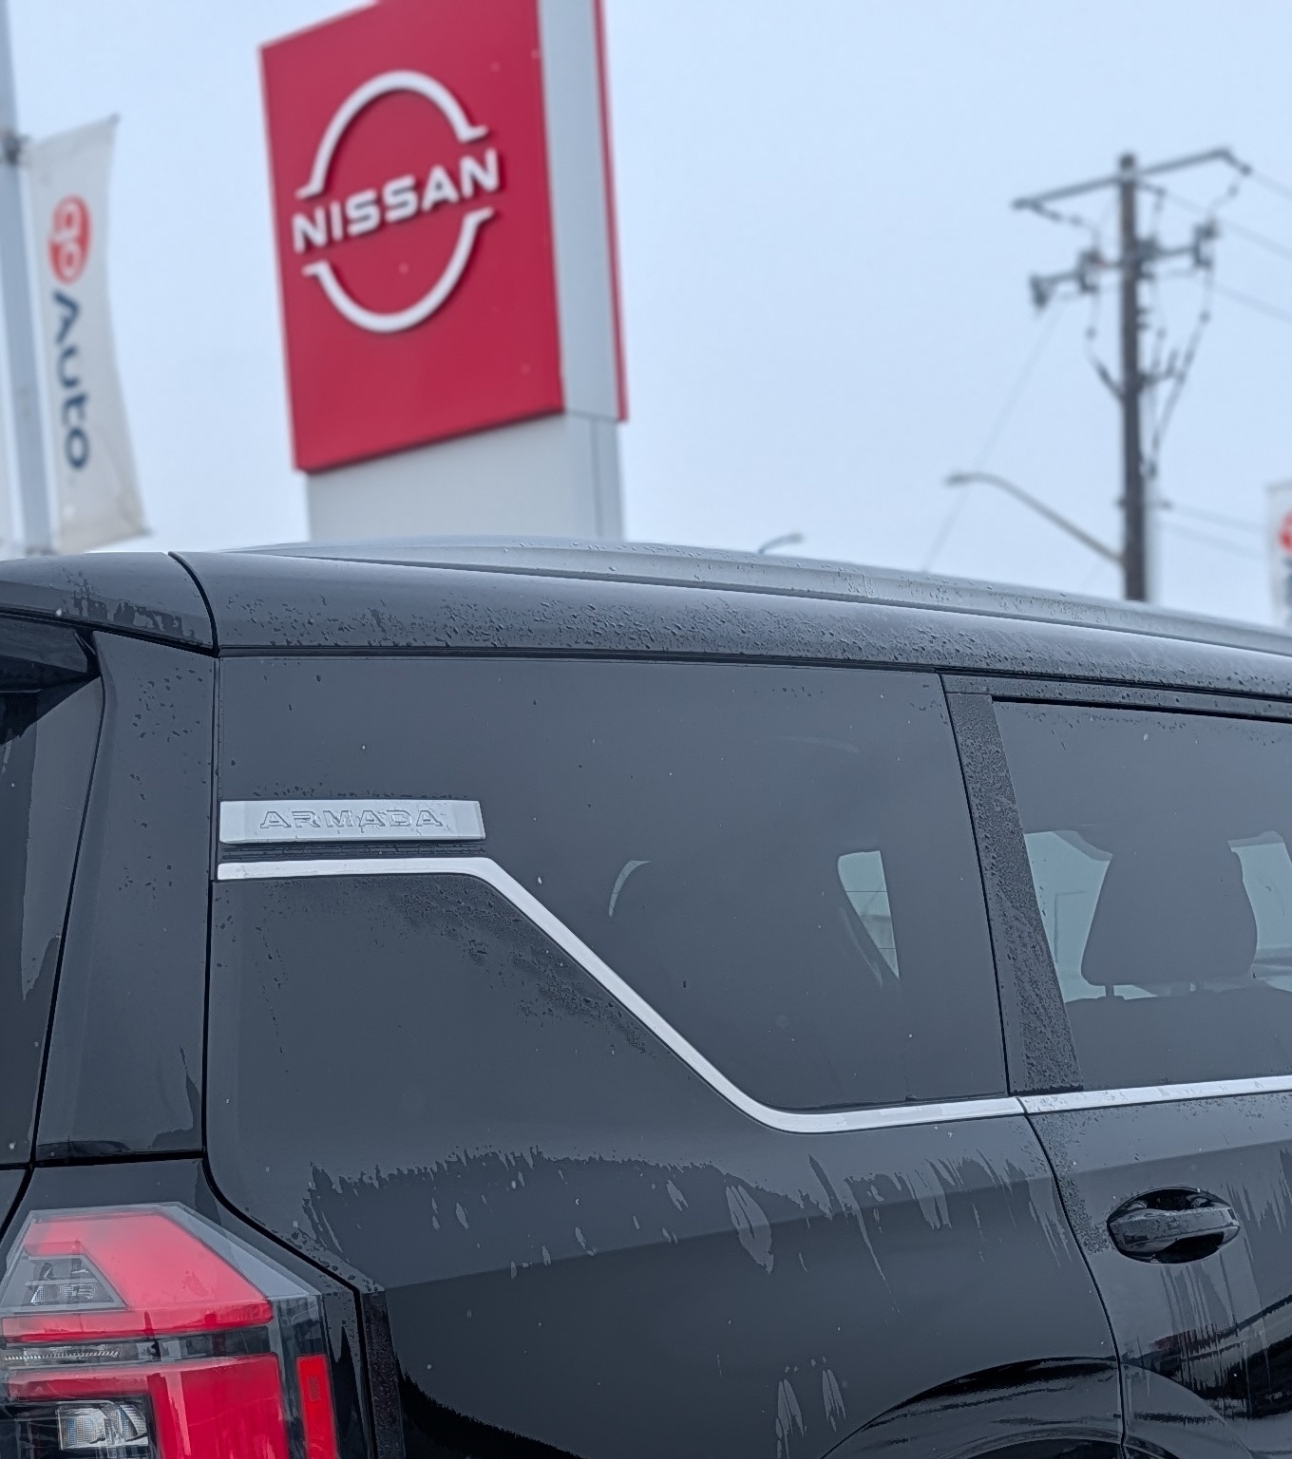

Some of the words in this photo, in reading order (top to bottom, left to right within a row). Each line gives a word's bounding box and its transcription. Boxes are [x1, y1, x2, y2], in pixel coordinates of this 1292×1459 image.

[293, 148, 501, 256] NISSAN
[53, 293, 91, 472] Auto
[260, 809, 444, 829] ARMADA
